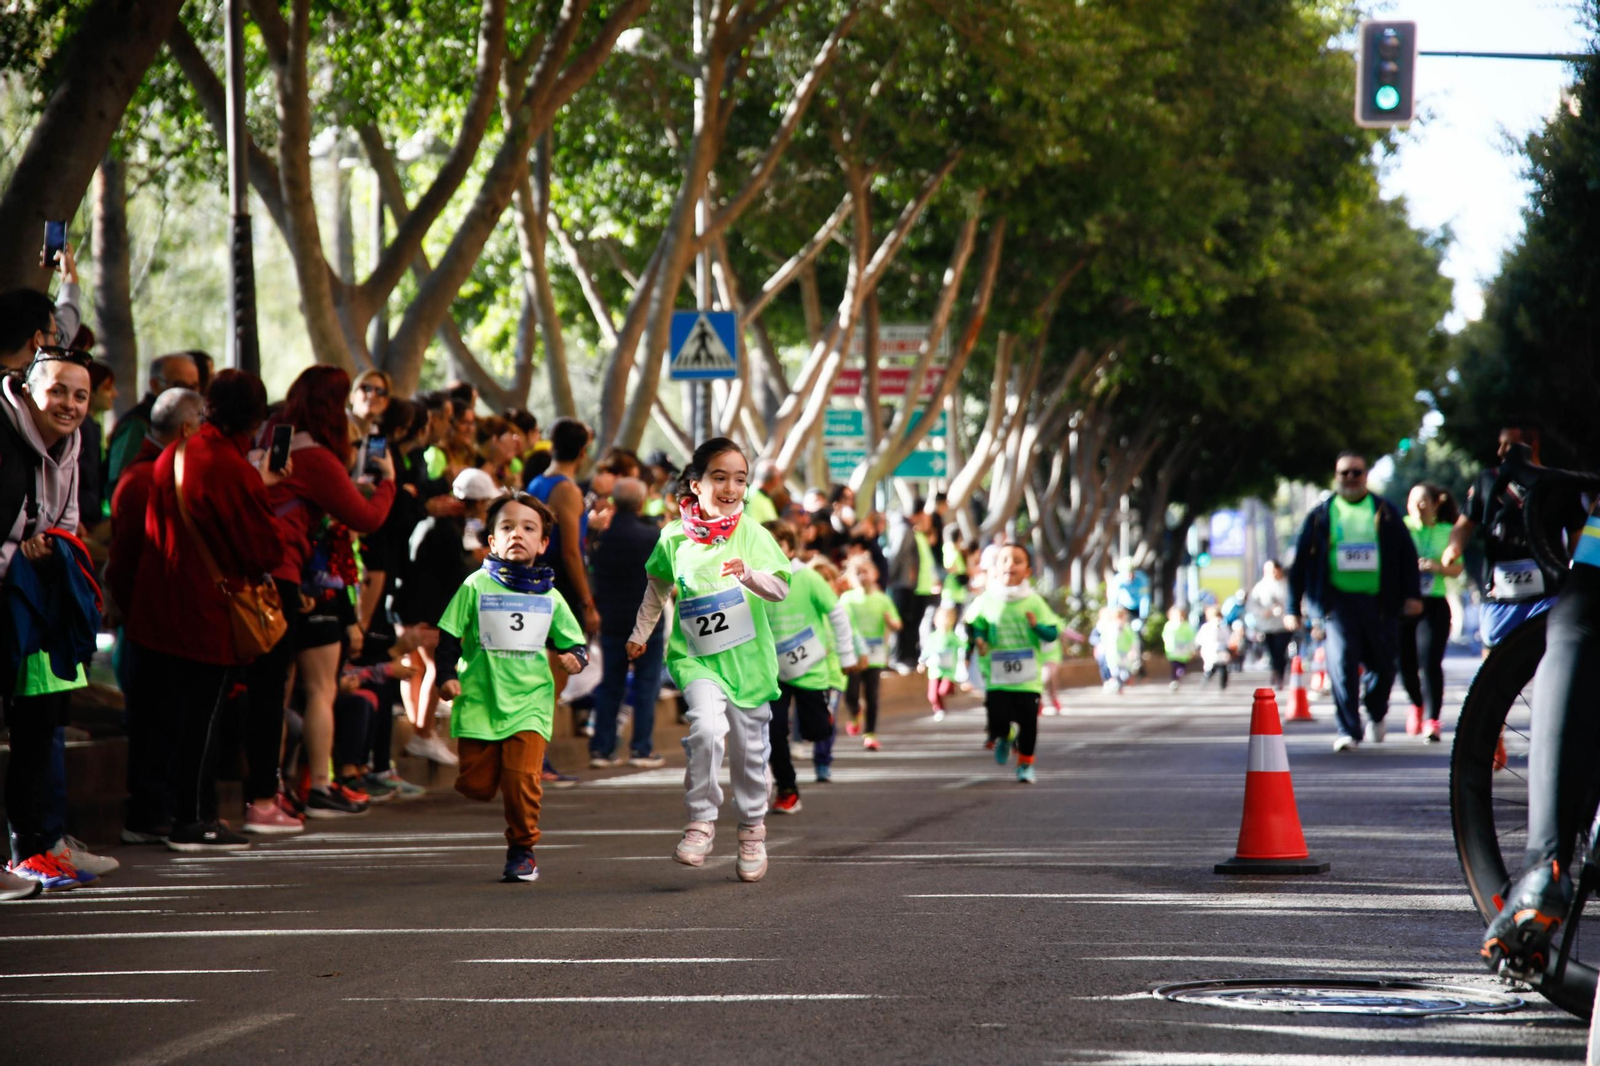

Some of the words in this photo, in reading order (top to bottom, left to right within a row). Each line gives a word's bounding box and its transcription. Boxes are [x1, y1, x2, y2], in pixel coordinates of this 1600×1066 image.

[1504, 571, 1532, 584] 522
[509, 612, 524, 632] 3
[695, 612, 730, 637] 22
[786, 645, 808, 665] 32
[1003, 660, 1022, 674] 90
